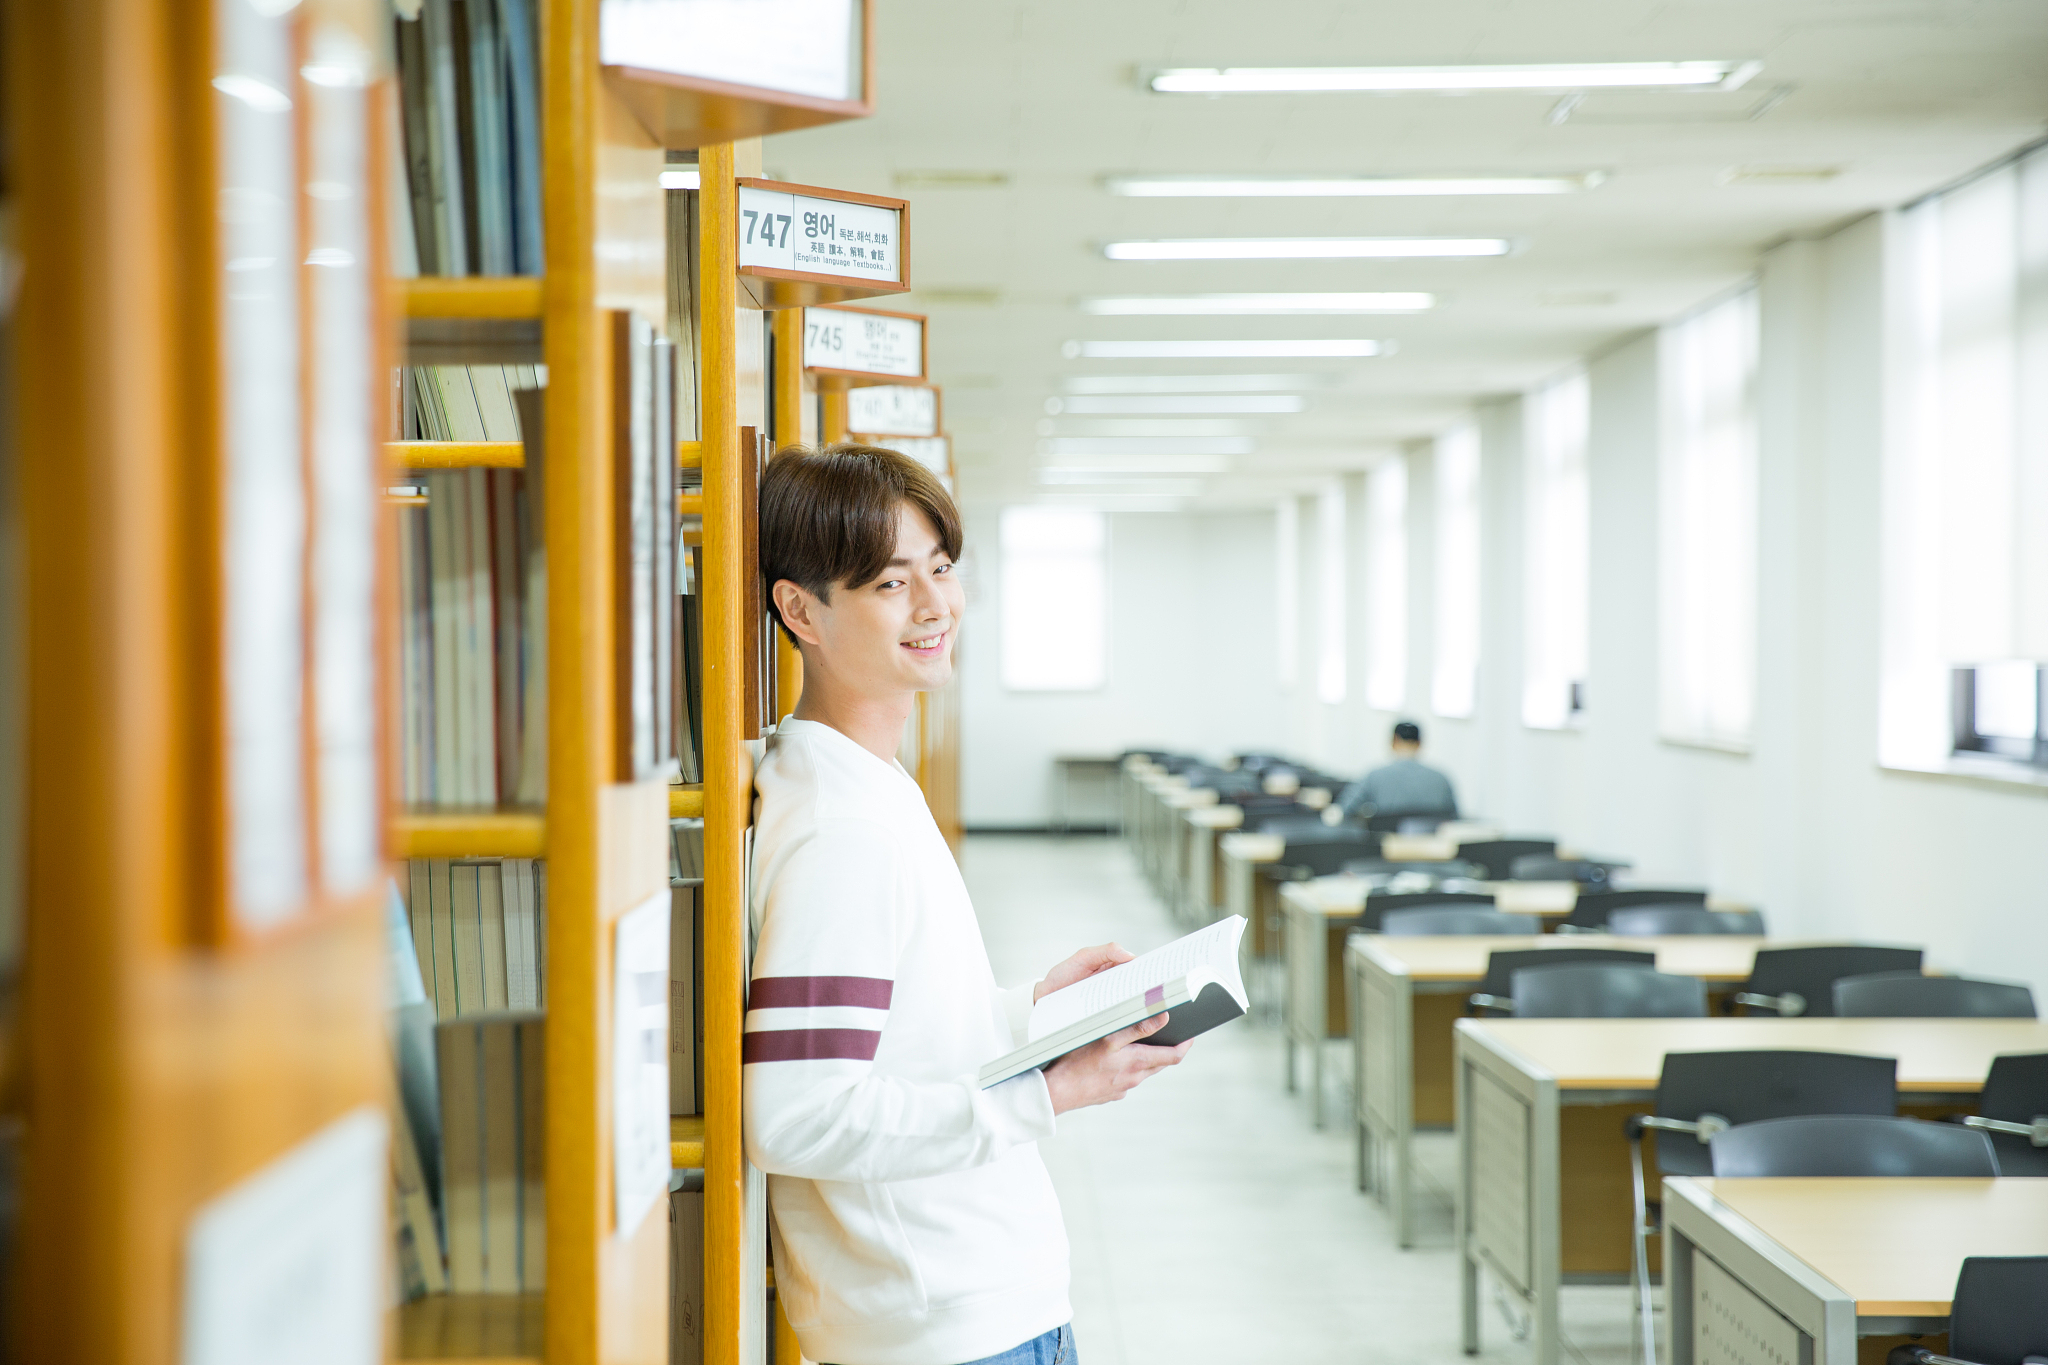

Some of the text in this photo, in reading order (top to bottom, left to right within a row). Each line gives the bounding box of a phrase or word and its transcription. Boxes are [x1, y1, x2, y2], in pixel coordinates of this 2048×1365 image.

[743, 209, 792, 249] 747
[803, 211, 835, 241] 영어
[795, 252, 821, 263] (English
[823, 255, 851, 267] language
[809, 323, 843, 352] 745
